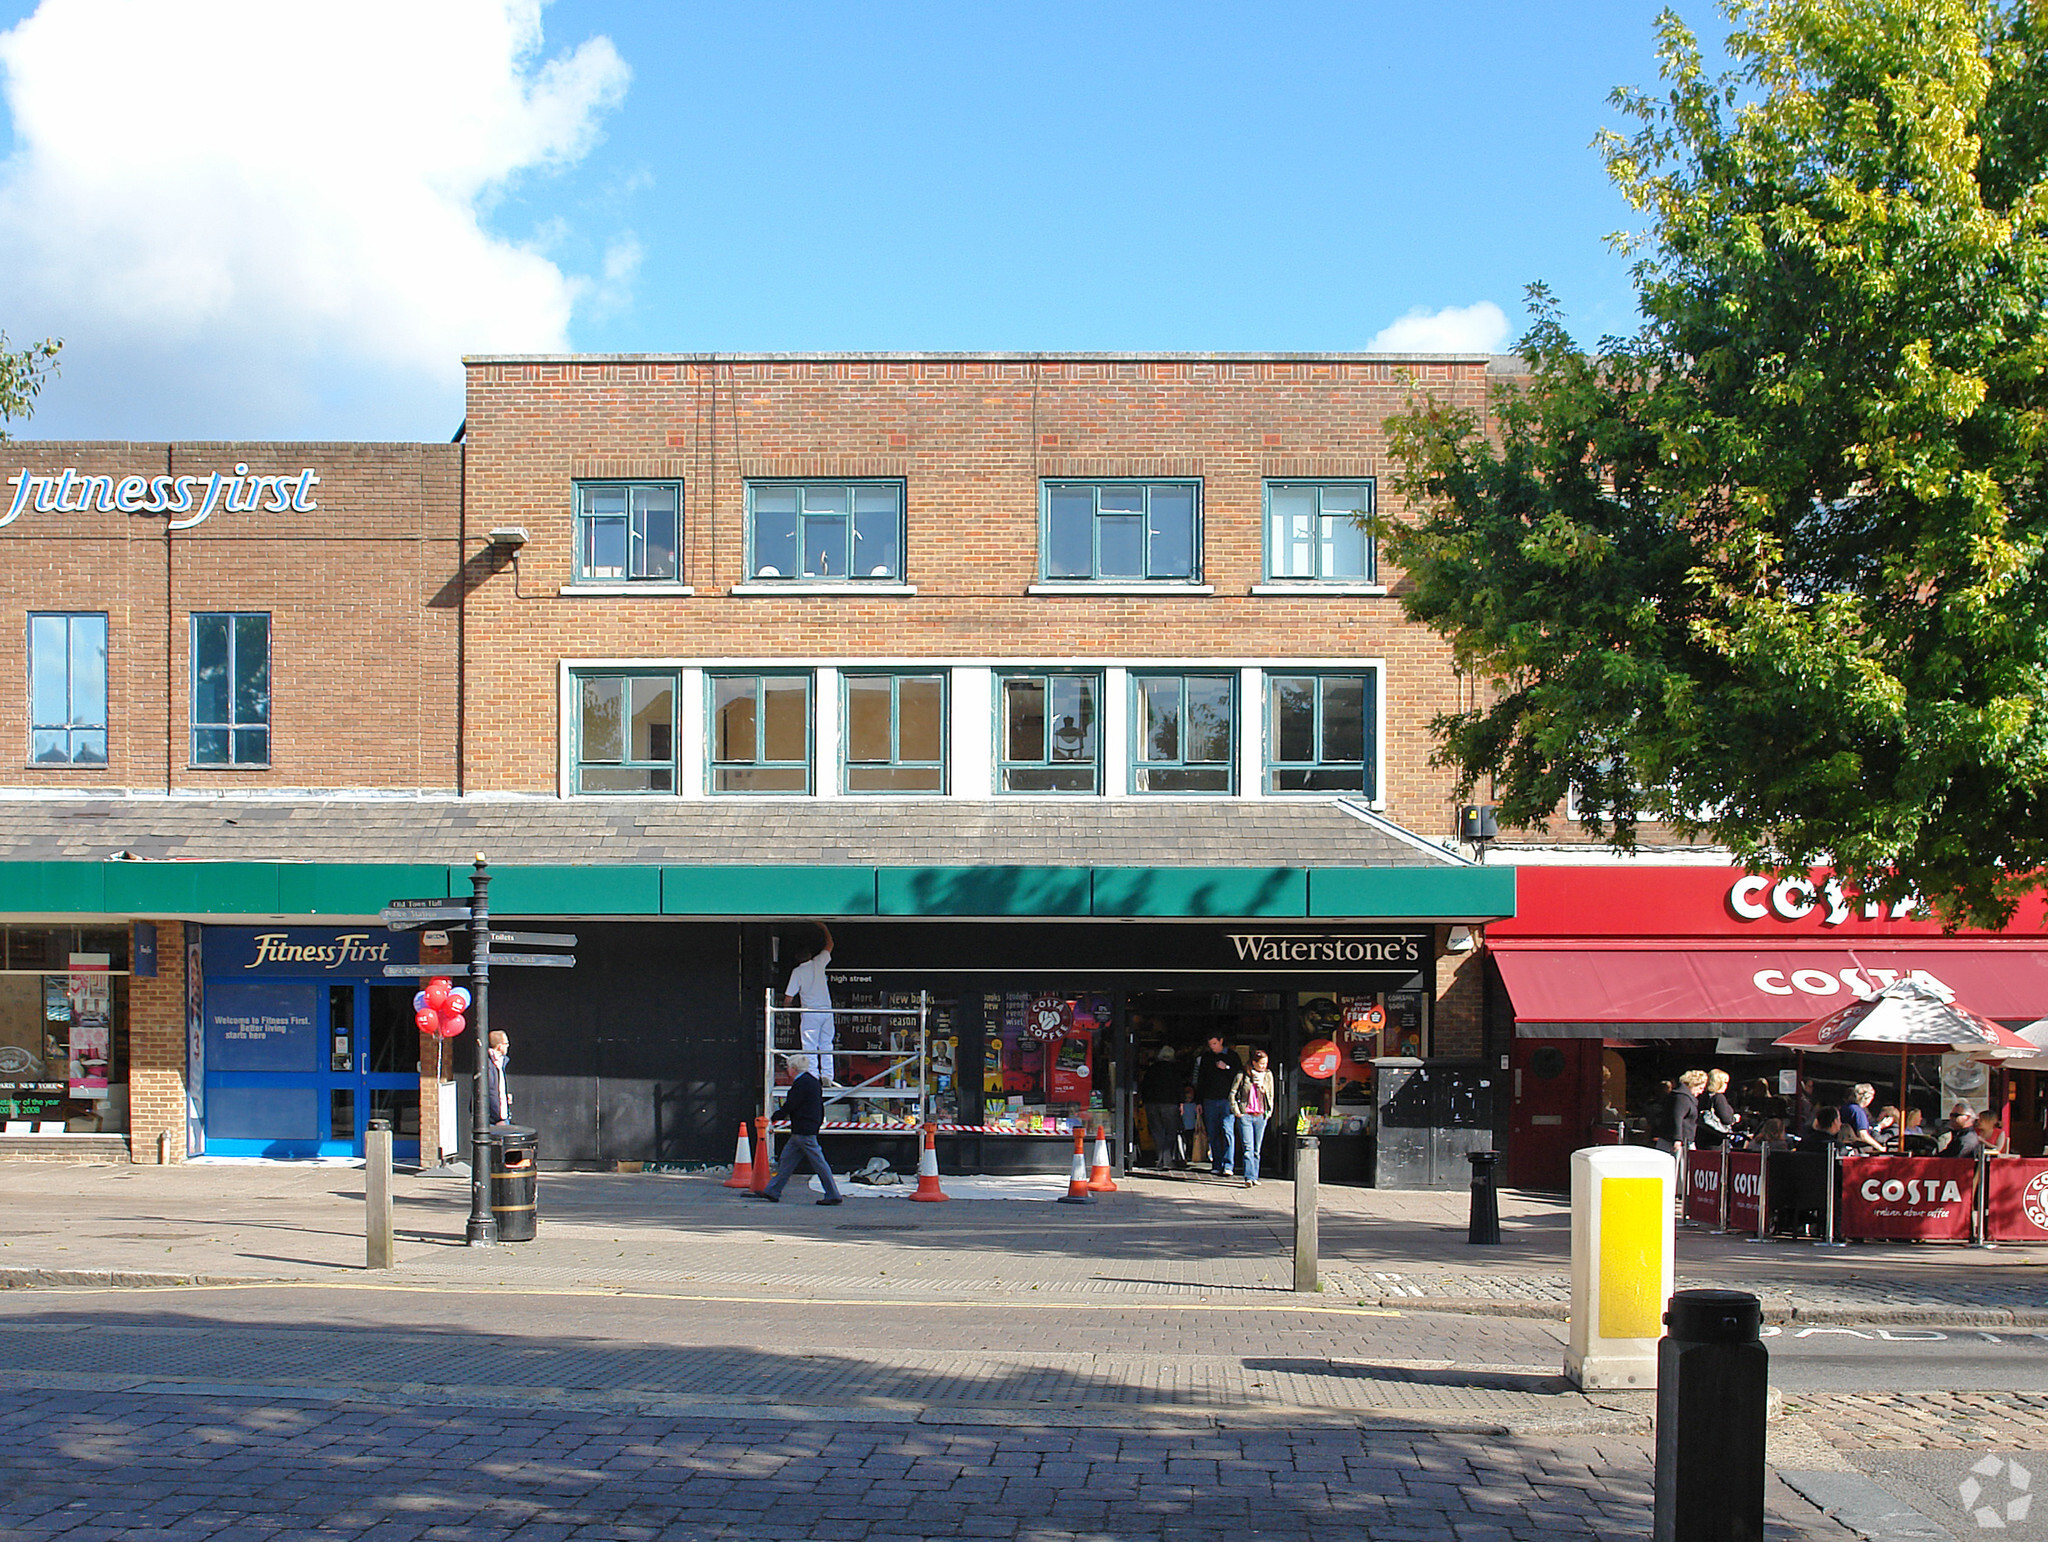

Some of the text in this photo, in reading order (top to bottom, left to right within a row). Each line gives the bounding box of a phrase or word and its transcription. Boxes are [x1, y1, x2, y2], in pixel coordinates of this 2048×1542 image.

[490, 933, 515, 941] Toilets
[1231, 936, 1419, 961] Waterstone's
[830, 975, 872, 984] high street
[911, 992, 935, 1005] boks
[1032, 999, 1065, 1013] COSTA
[213, 1015, 250, 1025] Welcome
[251, 1015, 260, 1025] to
[261, 1015, 289, 1025] Fitness
[889, 1016, 917, 1026] season
[239, 1024, 287, 1034] Better living
[1029, 1024, 1069, 1040] COFFEE
[225, 1032, 267, 1040] starts here
[1694, 1169, 1719, 1192] COSTA
[1861, 1179, 1963, 1205] COSTA
